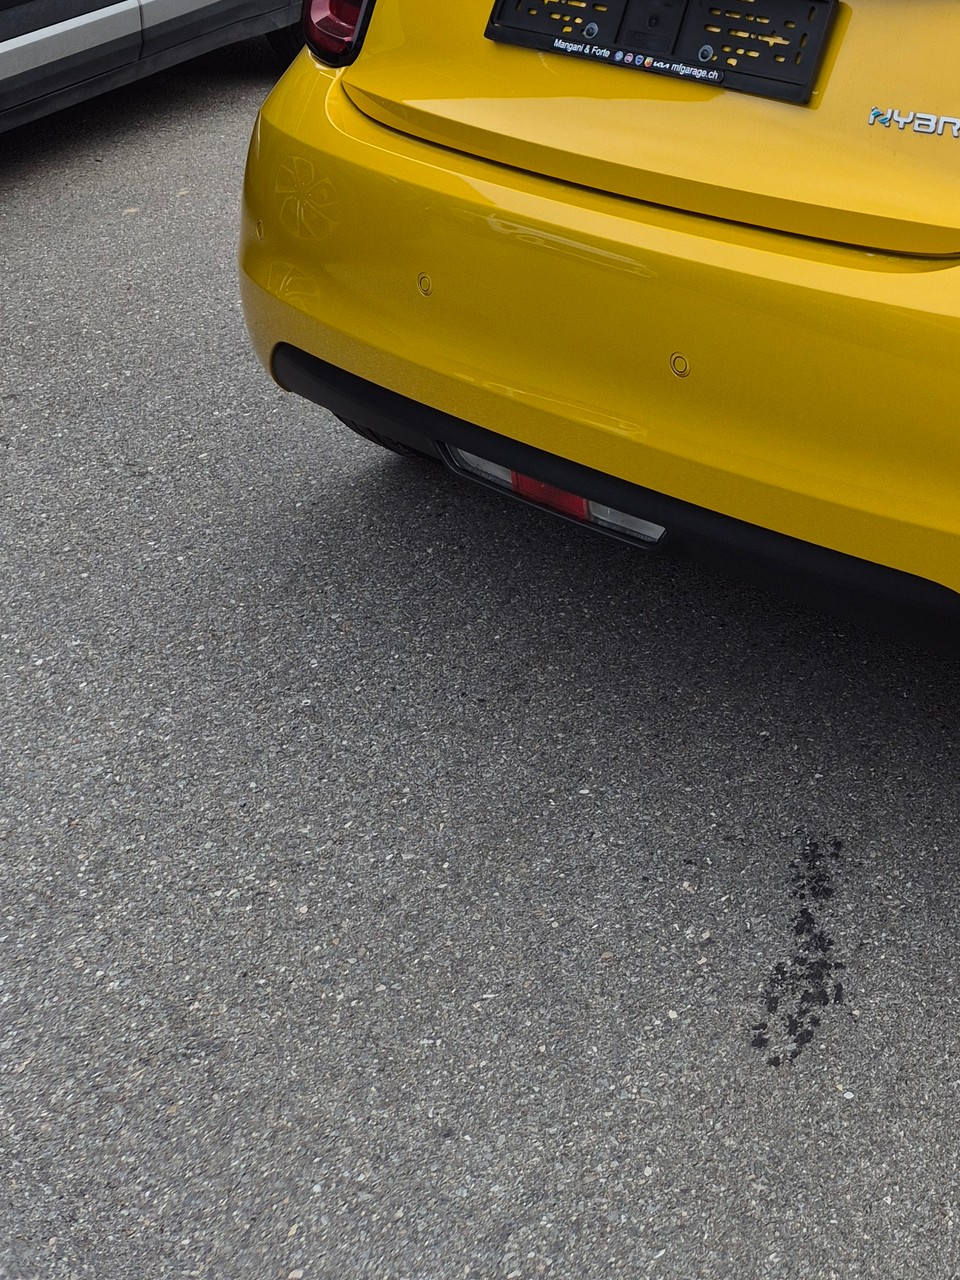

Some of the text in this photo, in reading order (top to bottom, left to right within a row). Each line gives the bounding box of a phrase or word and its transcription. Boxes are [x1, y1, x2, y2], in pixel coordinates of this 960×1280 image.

[553, 38, 584, 54] Mangani
[584, 45, 591, 54] &
[591, 45, 611, 58] Forte
